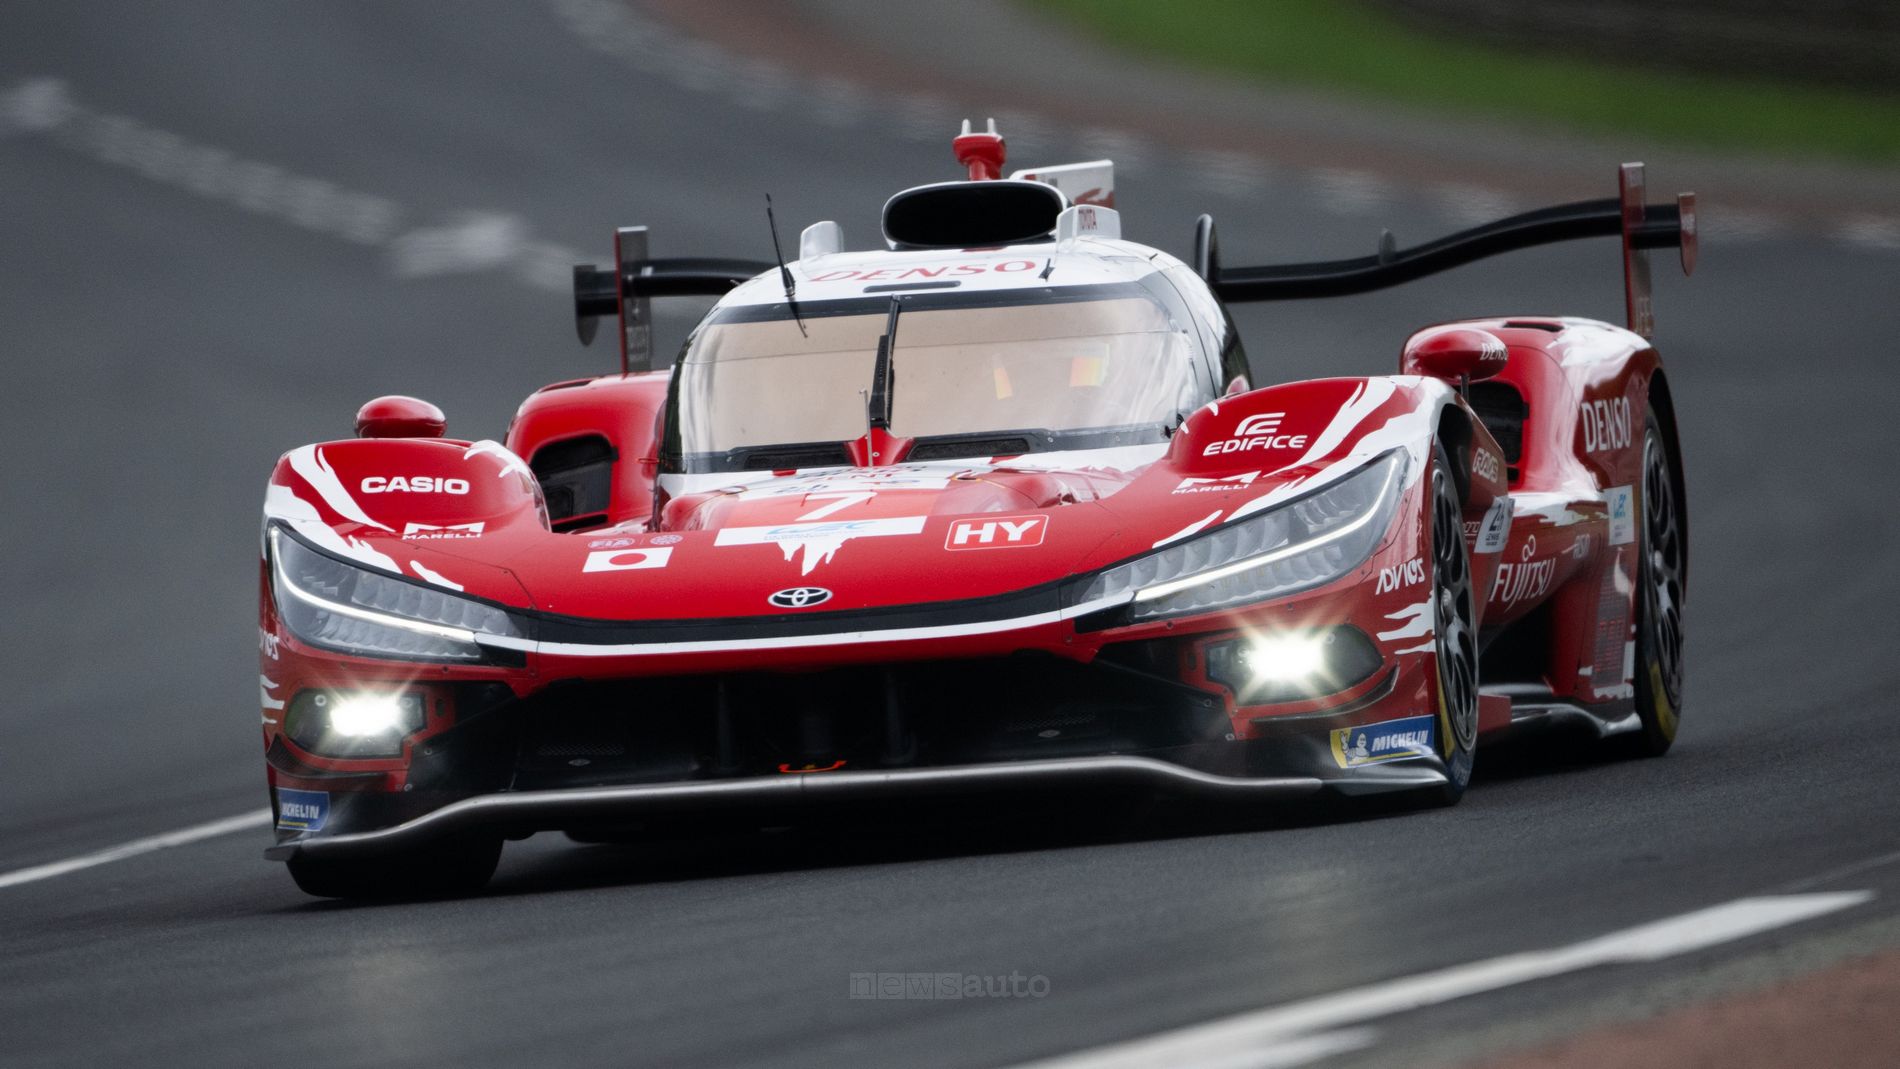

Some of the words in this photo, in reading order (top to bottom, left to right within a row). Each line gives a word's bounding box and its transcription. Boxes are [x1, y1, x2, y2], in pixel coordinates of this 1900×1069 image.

[809, 260, 1036, 282] DENSO
[1581, 396, 1632, 453] DENSO
[1203, 434, 1308, 457] EDIFICE
[361, 476, 470, 495] CASIO
[1172, 484, 1250, 495] MARELLI
[795, 491, 878, 522] 7
[401, 532, 483, 540] MARELLI
[954, 520, 1035, 546] HY
[1375, 558, 1426, 596] ADVICS
[1488, 557, 1556, 614] FUJITSU
[1371, 730, 1429, 753] MICHELIN
